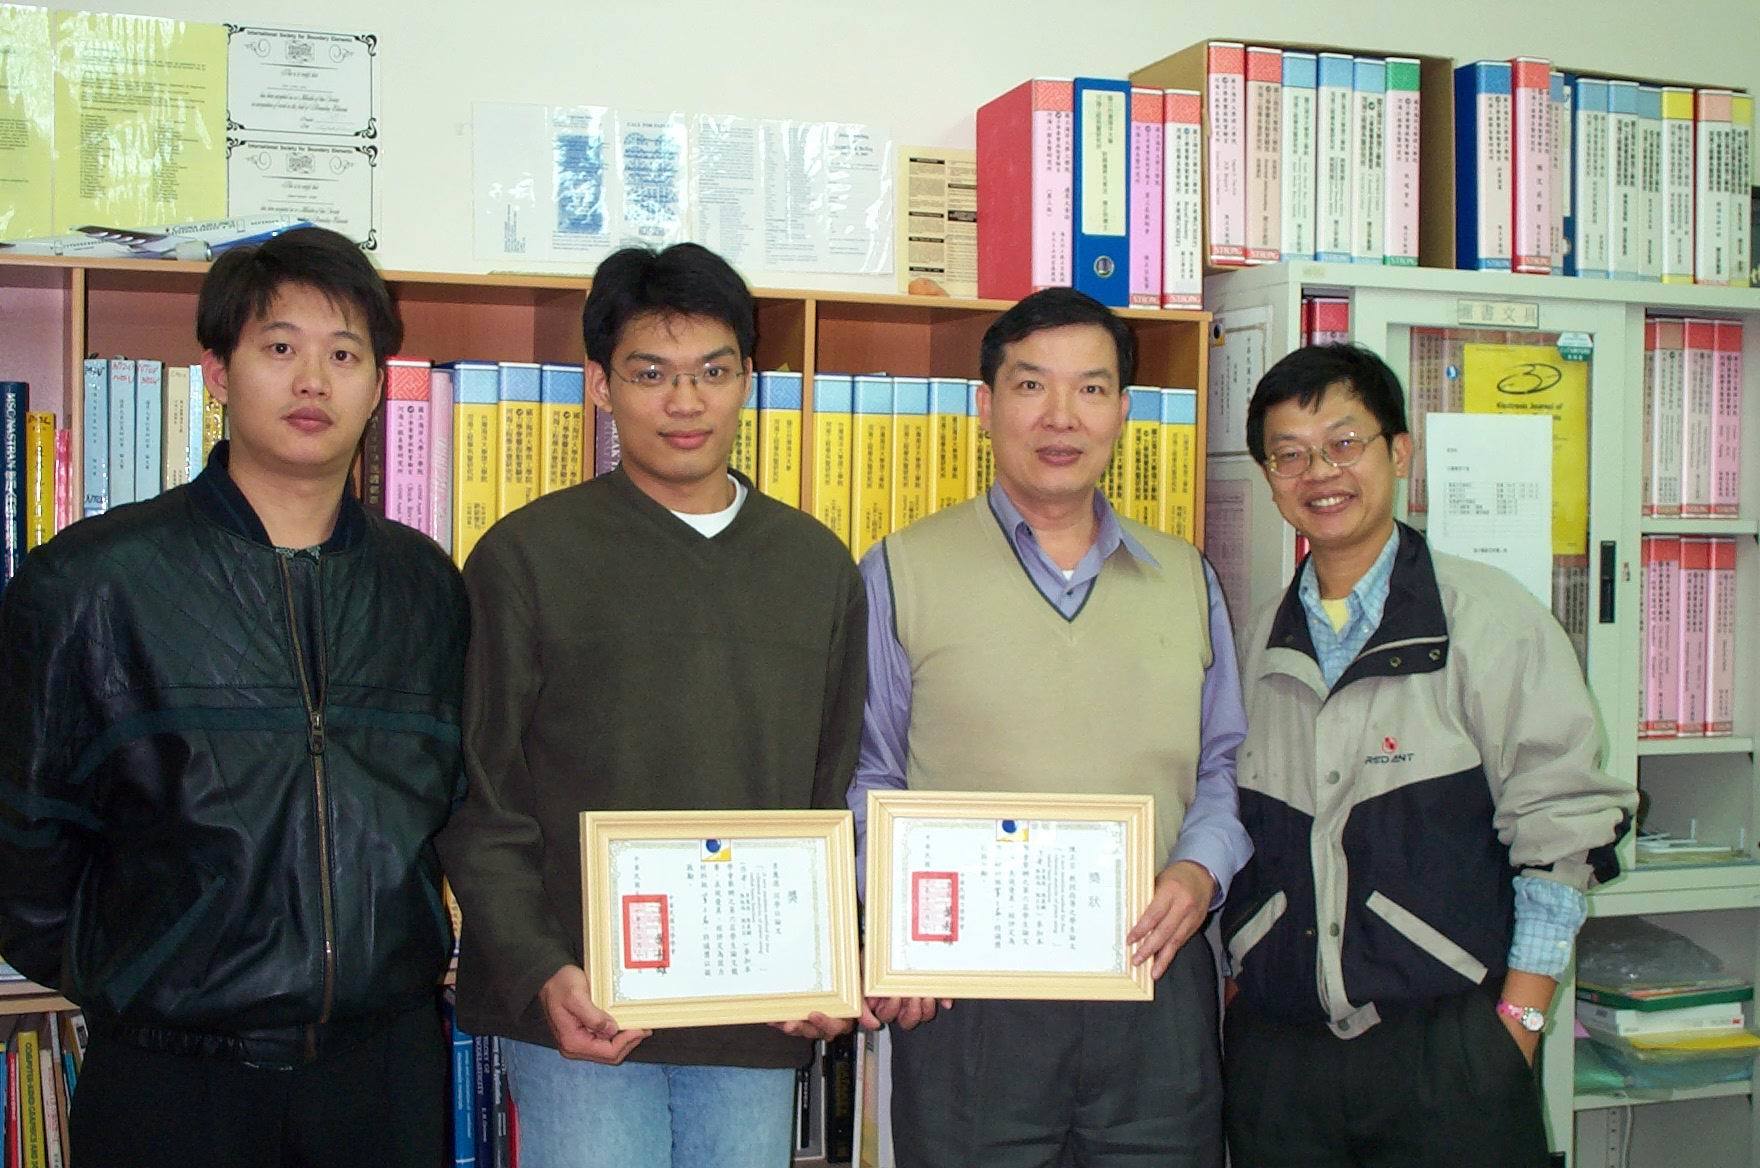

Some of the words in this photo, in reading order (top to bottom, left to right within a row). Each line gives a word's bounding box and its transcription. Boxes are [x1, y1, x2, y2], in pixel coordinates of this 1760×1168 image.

[280, 32, 297, 40] Society
[307, 34, 330, 42] Boundary
[1530, 402, 1553, 410] Journal
[5, 393, 17, 469] MSC/NASTRAN
